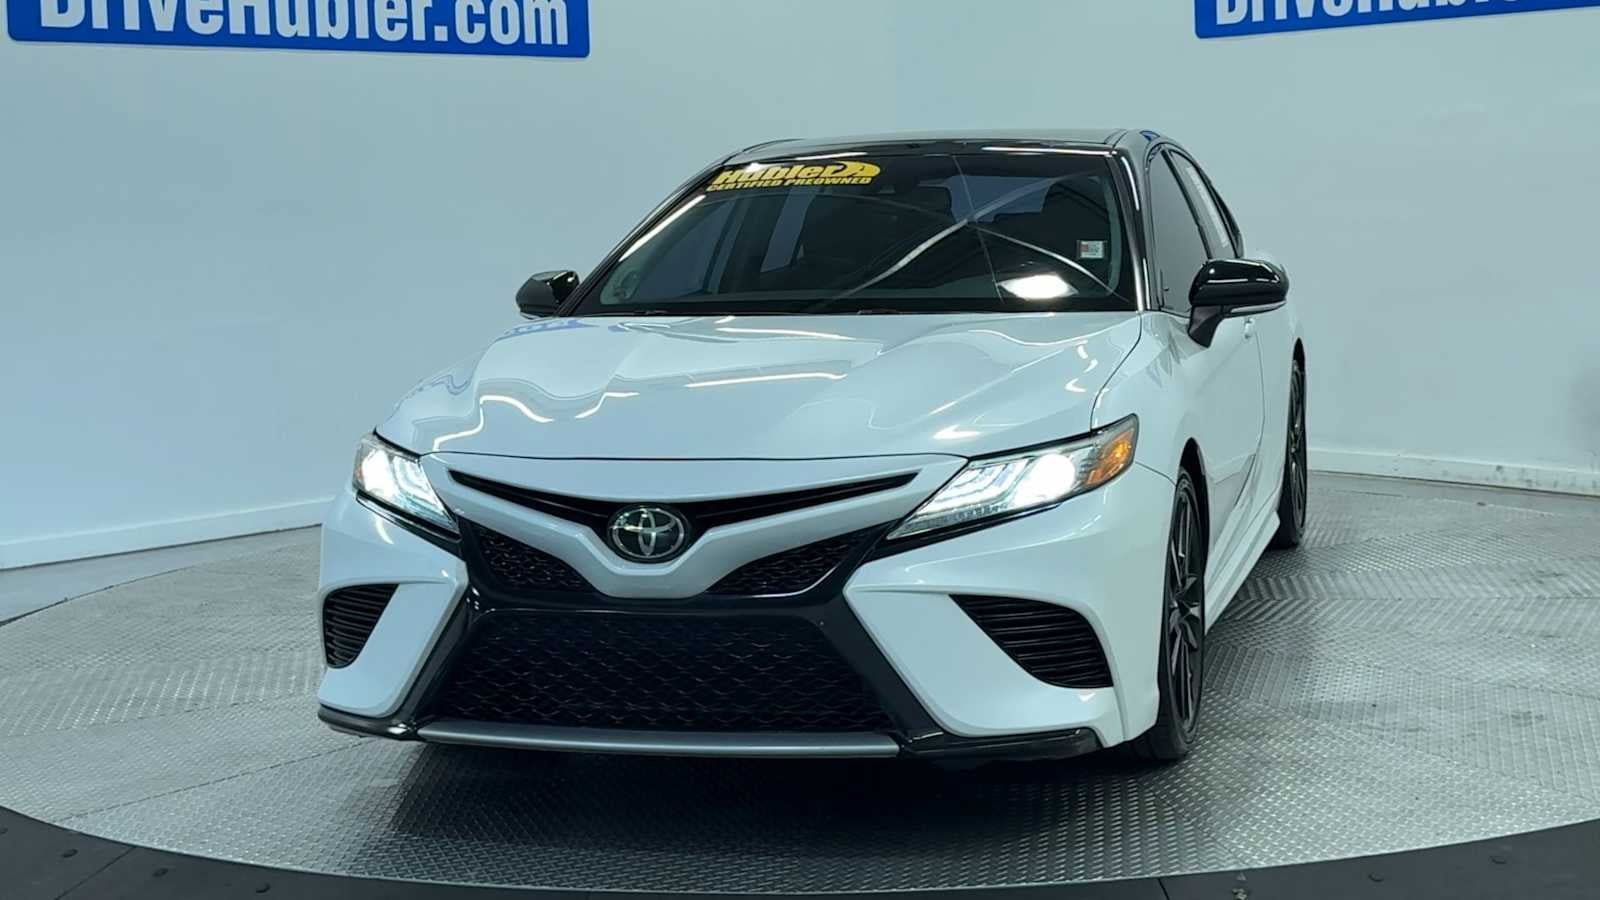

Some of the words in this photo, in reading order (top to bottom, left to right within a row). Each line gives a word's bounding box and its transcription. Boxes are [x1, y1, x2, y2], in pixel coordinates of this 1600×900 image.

[711, 163, 841, 185] Hubler
[705, 179, 783, 192] CERTIFIED
[783, 176, 873, 186] PREOWNED
